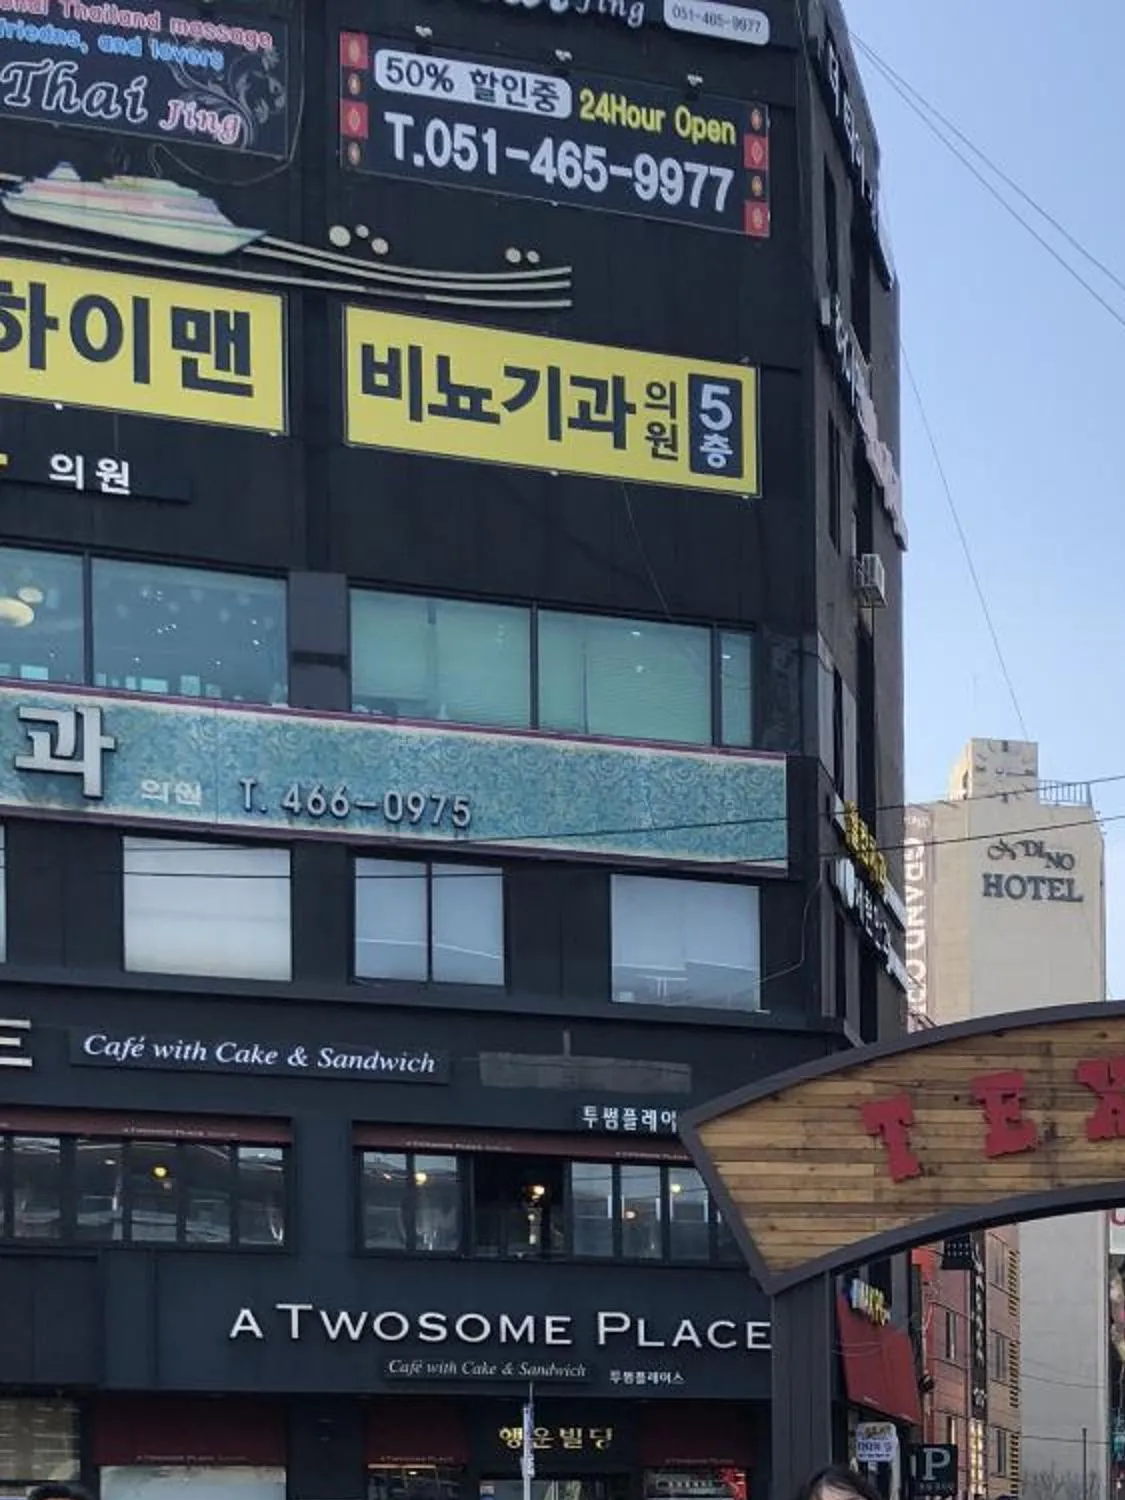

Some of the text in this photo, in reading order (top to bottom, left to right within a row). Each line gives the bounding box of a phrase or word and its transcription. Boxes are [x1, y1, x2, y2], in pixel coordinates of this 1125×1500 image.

[97, 34, 142, 57] and
[151, 38, 225, 72] lovers
[169, 15, 273, 51] massage
[0, 58, 242, 146] Thai Jing
[386, 57, 737, 146] 50% 할인중 24Hour Open
[383, 111, 735, 213] T.051-465-9977
[0, 280, 254, 398] 하이맨
[361, 342, 734, 470] 비뇨기과 의원 5층
[49, 453, 131, 496] 의원
[14, 704, 473, 829] 과 의원 T. 466-0975
[982, 873, 1084, 903] HOTEL
[82, 1033, 436, 1074] Café with Cake & Sandwich
[229, 1303, 773, 1350] A TWOSOME PLACE
[388, 1359, 587, 1378] Café with Cake & Sandwich
[922, 1447, 952, 1481] P
